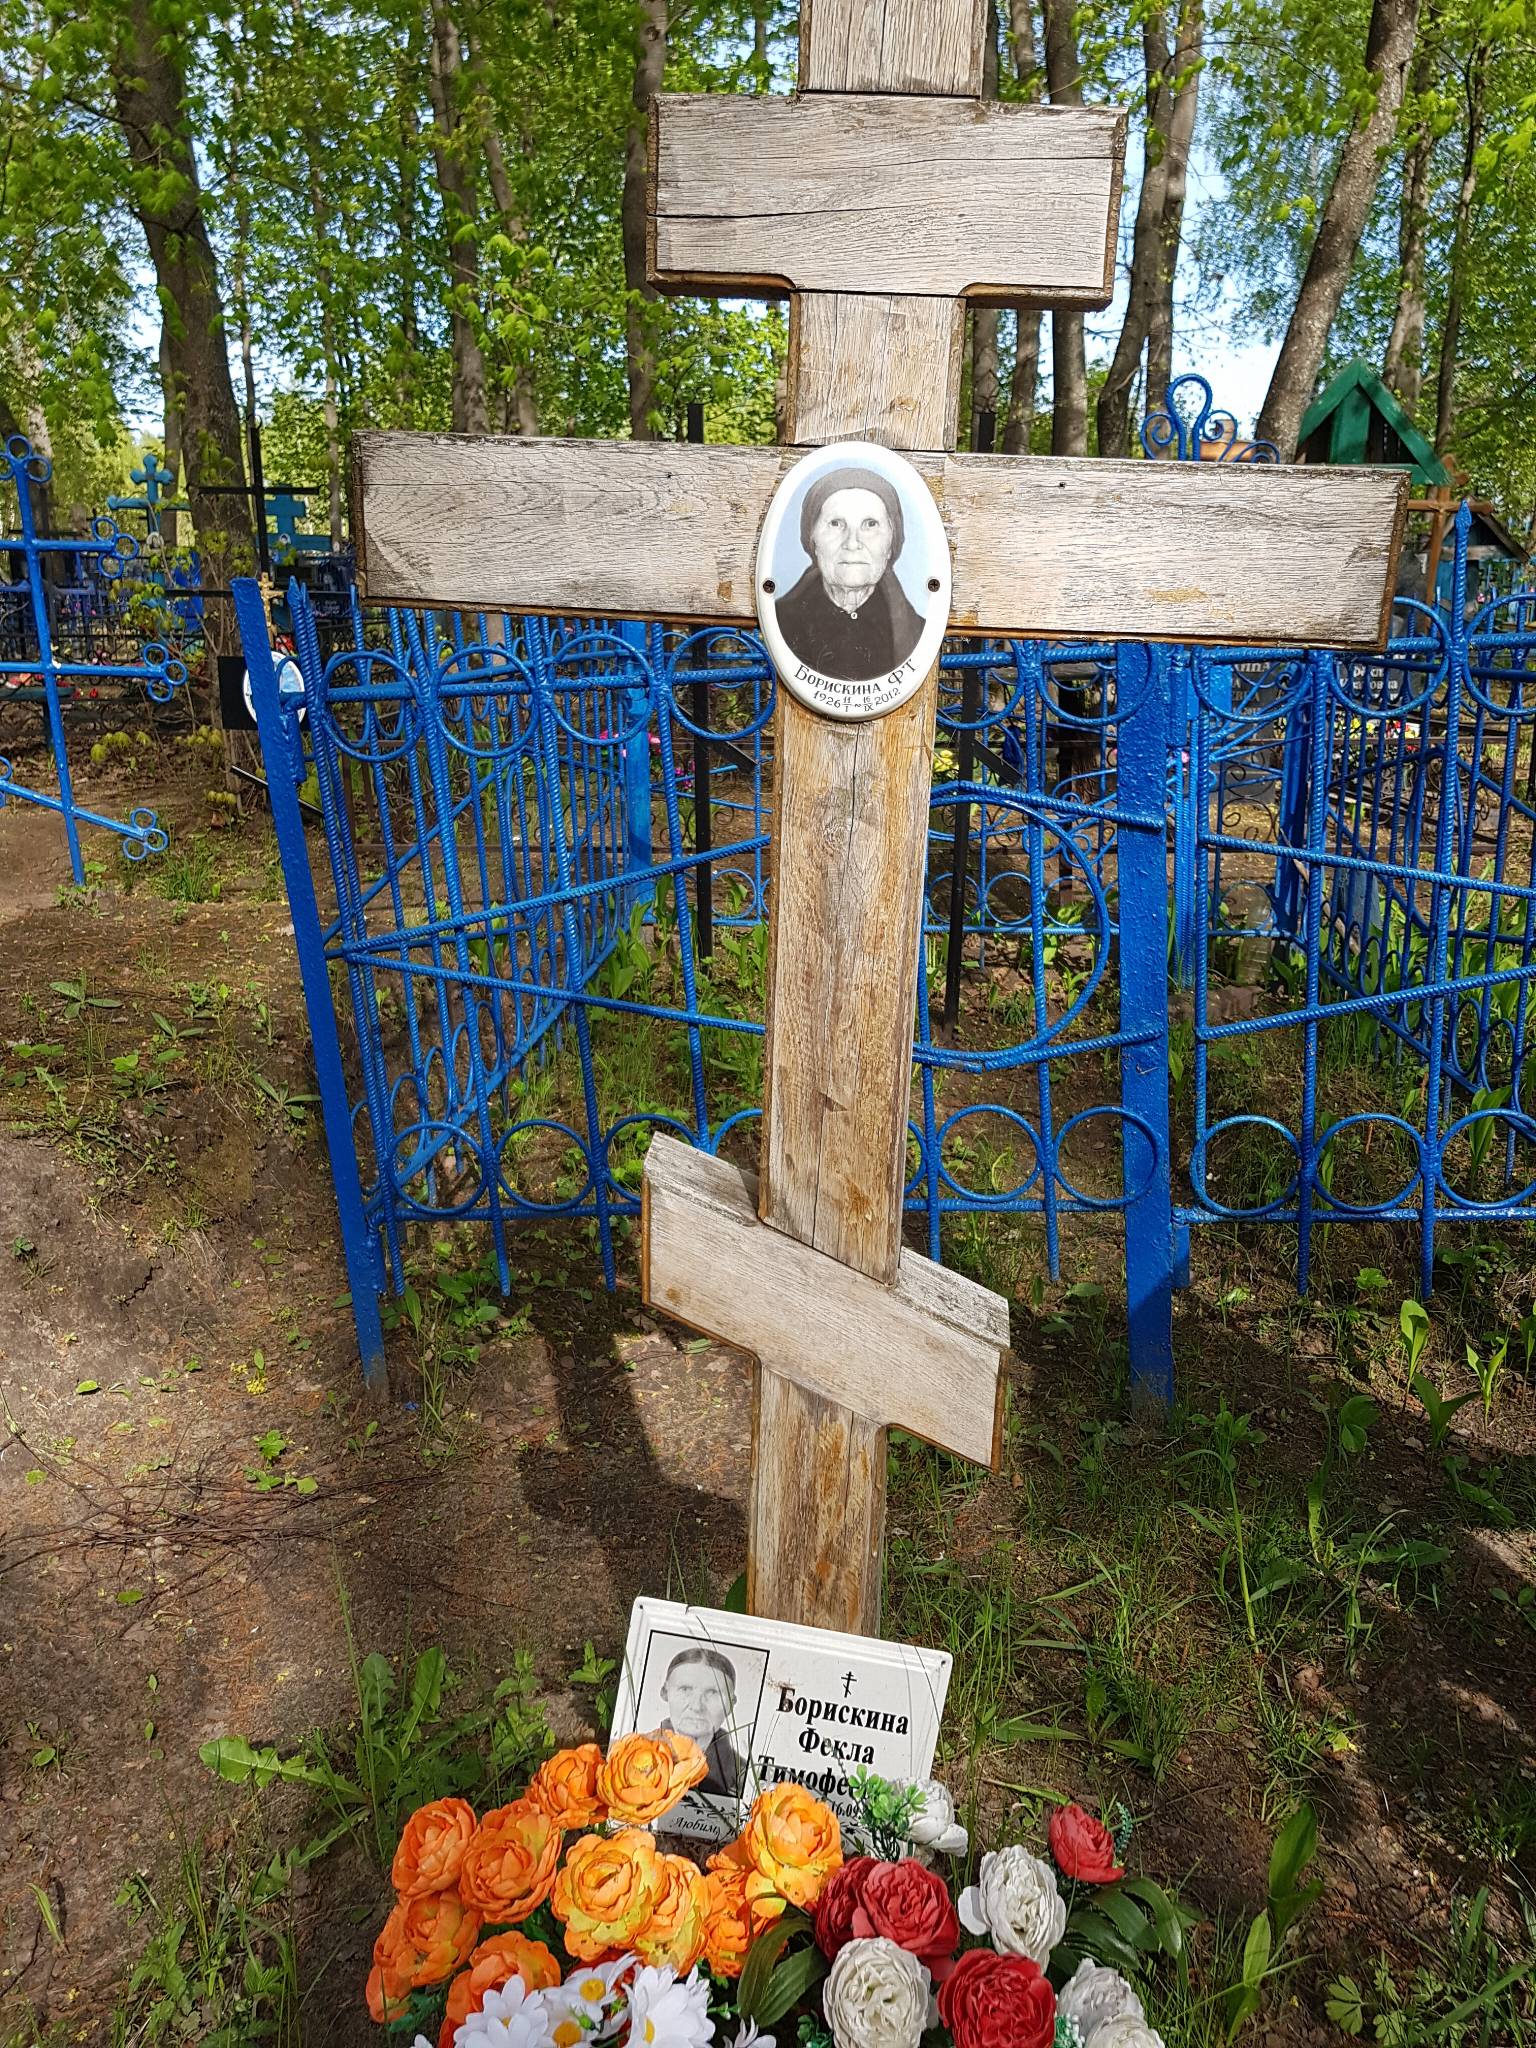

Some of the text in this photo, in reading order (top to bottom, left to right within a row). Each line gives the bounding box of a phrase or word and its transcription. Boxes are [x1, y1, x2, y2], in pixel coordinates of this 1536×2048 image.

[813, 691, 841, 708] 1926
[875, 688, 900, 705] 2012
[776, 1686, 910, 1736] Борискина
[798, 1728, 875, 1765] Фекла
